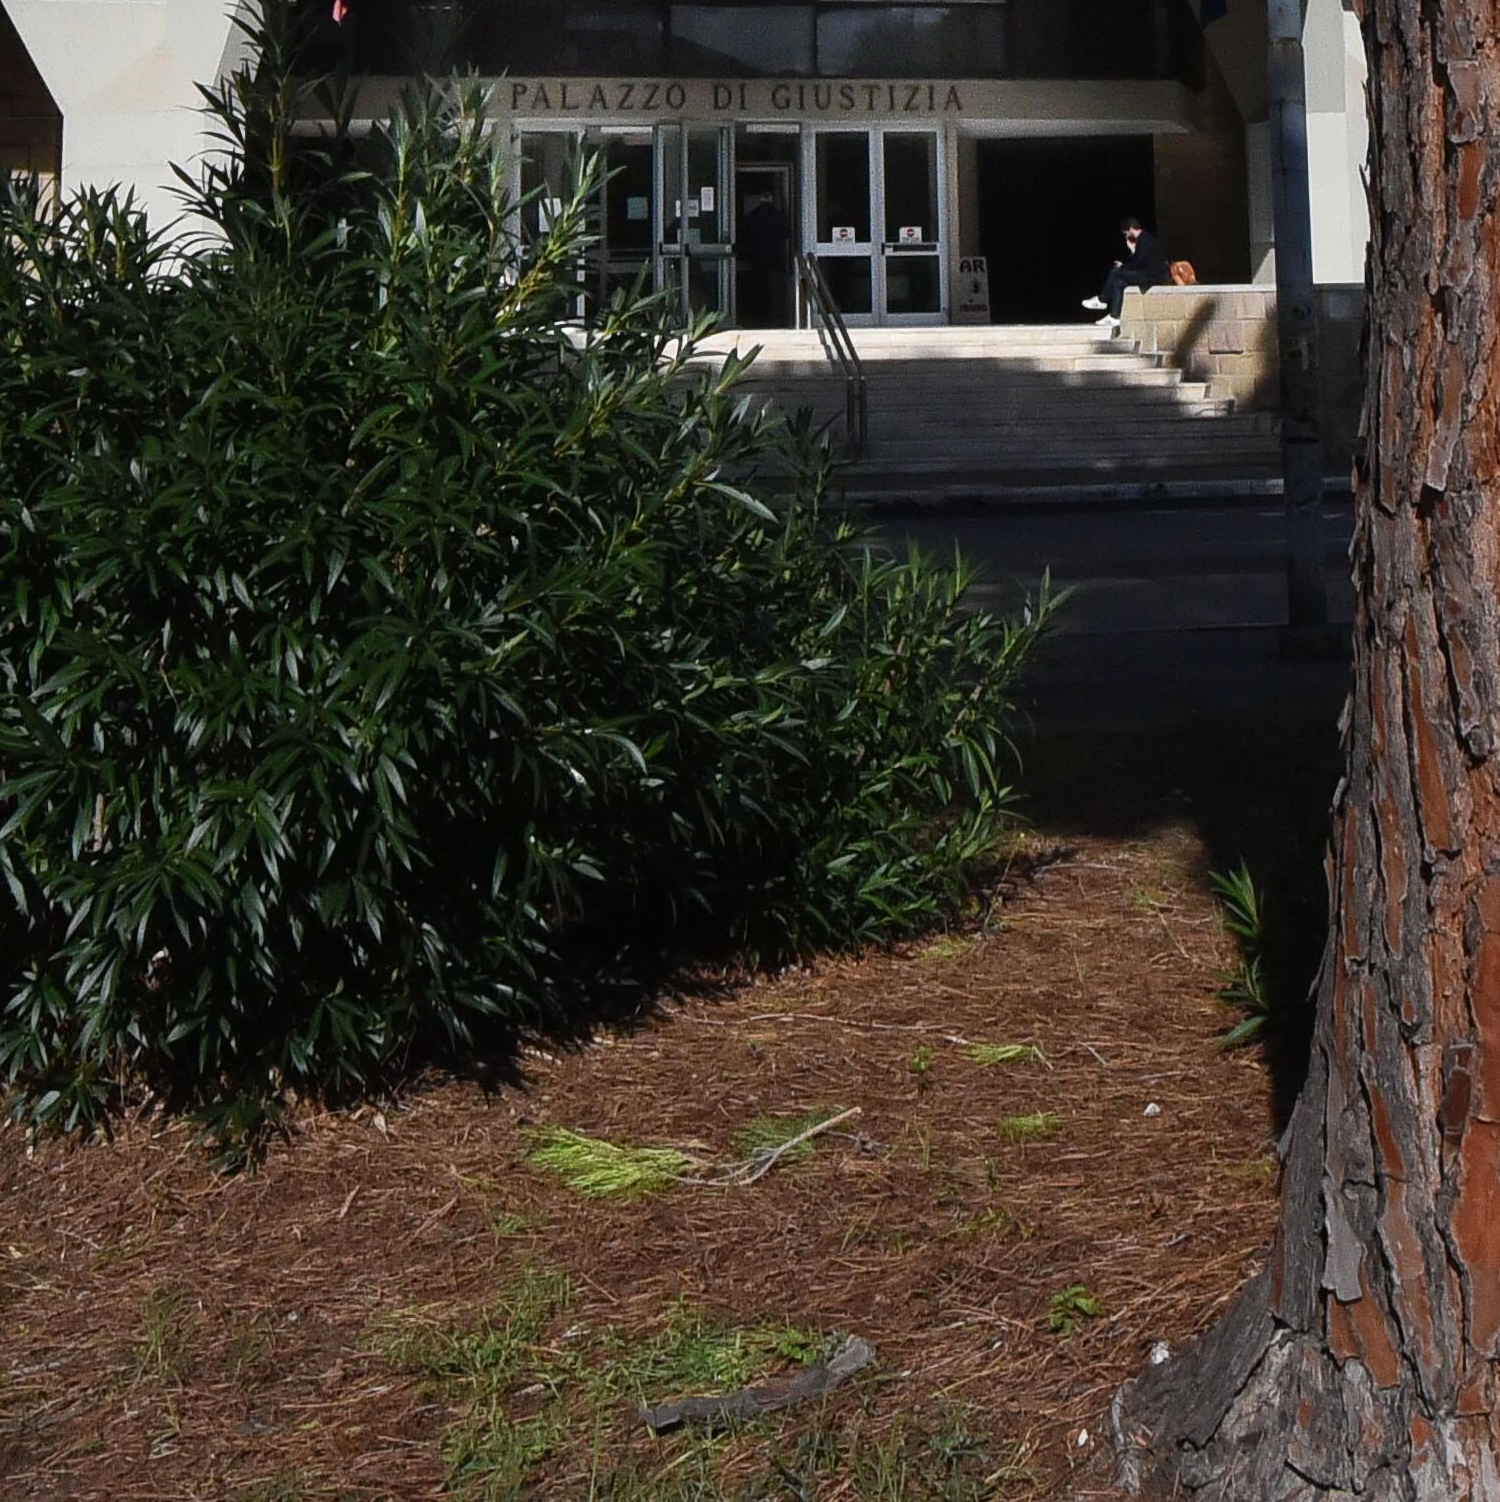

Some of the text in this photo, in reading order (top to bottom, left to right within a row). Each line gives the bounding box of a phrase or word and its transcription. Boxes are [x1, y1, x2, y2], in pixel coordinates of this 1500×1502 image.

[511, 82, 963, 112] PALAZZO DI GIUSTIZIA
